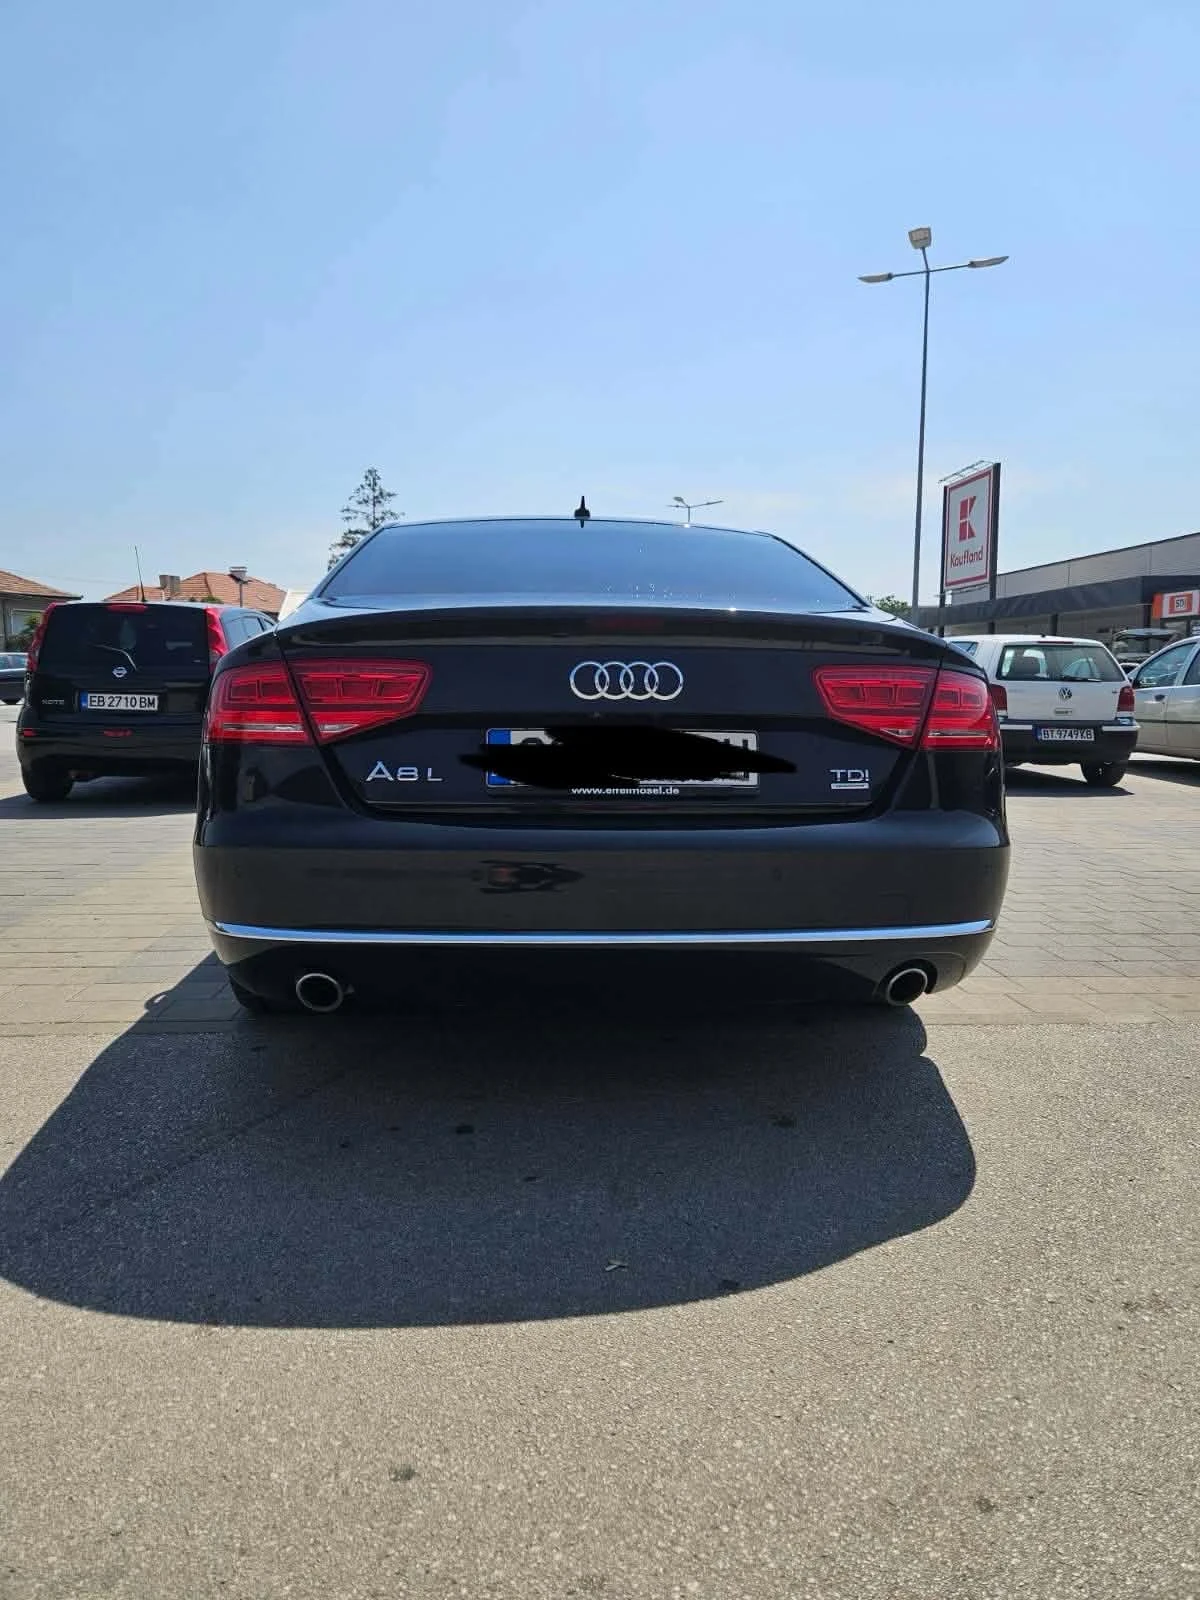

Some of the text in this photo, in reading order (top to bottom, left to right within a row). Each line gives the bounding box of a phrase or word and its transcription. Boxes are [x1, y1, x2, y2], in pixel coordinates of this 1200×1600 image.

[950, 545, 983, 568] Kaufland
[89, 695, 156, 709] EB 2710 BM
[365, 760, 444, 782] A8 L
